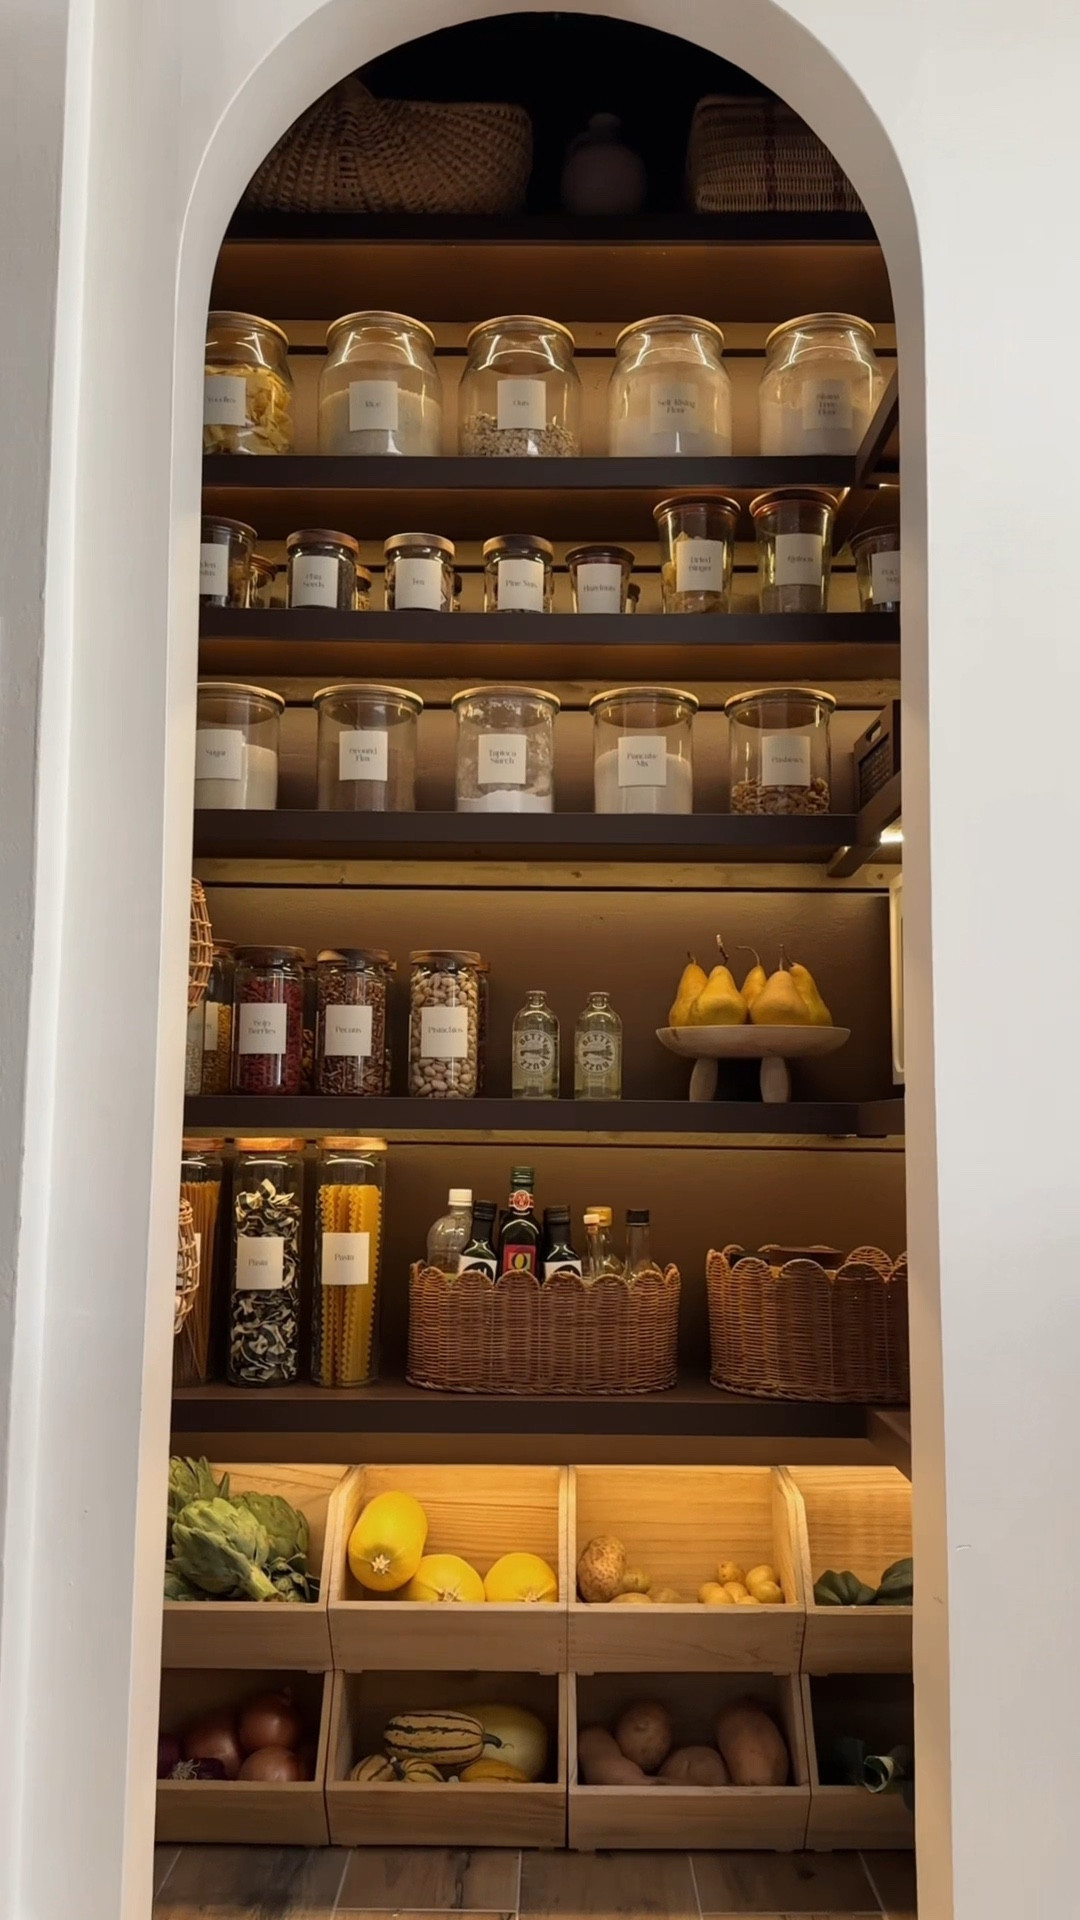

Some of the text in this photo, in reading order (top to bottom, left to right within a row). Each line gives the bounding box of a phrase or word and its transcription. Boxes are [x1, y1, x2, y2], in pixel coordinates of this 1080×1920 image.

[505, 578, 522, 587] Pine
[489, 749, 517, 759] Tapioca
[490, 757, 515, 765] Starch
[636, 760, 649, 768] Mix
[248, 1027, 276, 1035] Berries
[335, 1025, 362, 1033] Pecans
[427, 1025, 464, 1033] Pistachios
[519, 1033, 549, 1045] BETTY
[582, 1034, 611, 1046] BETTY
[520, 1060, 547, 1070] BUZZ
[583, 1061, 610, 1071] BUZZ
[334, 1253, 355, 1261] Pasta
[248, 1258, 268, 1266] Pasta
